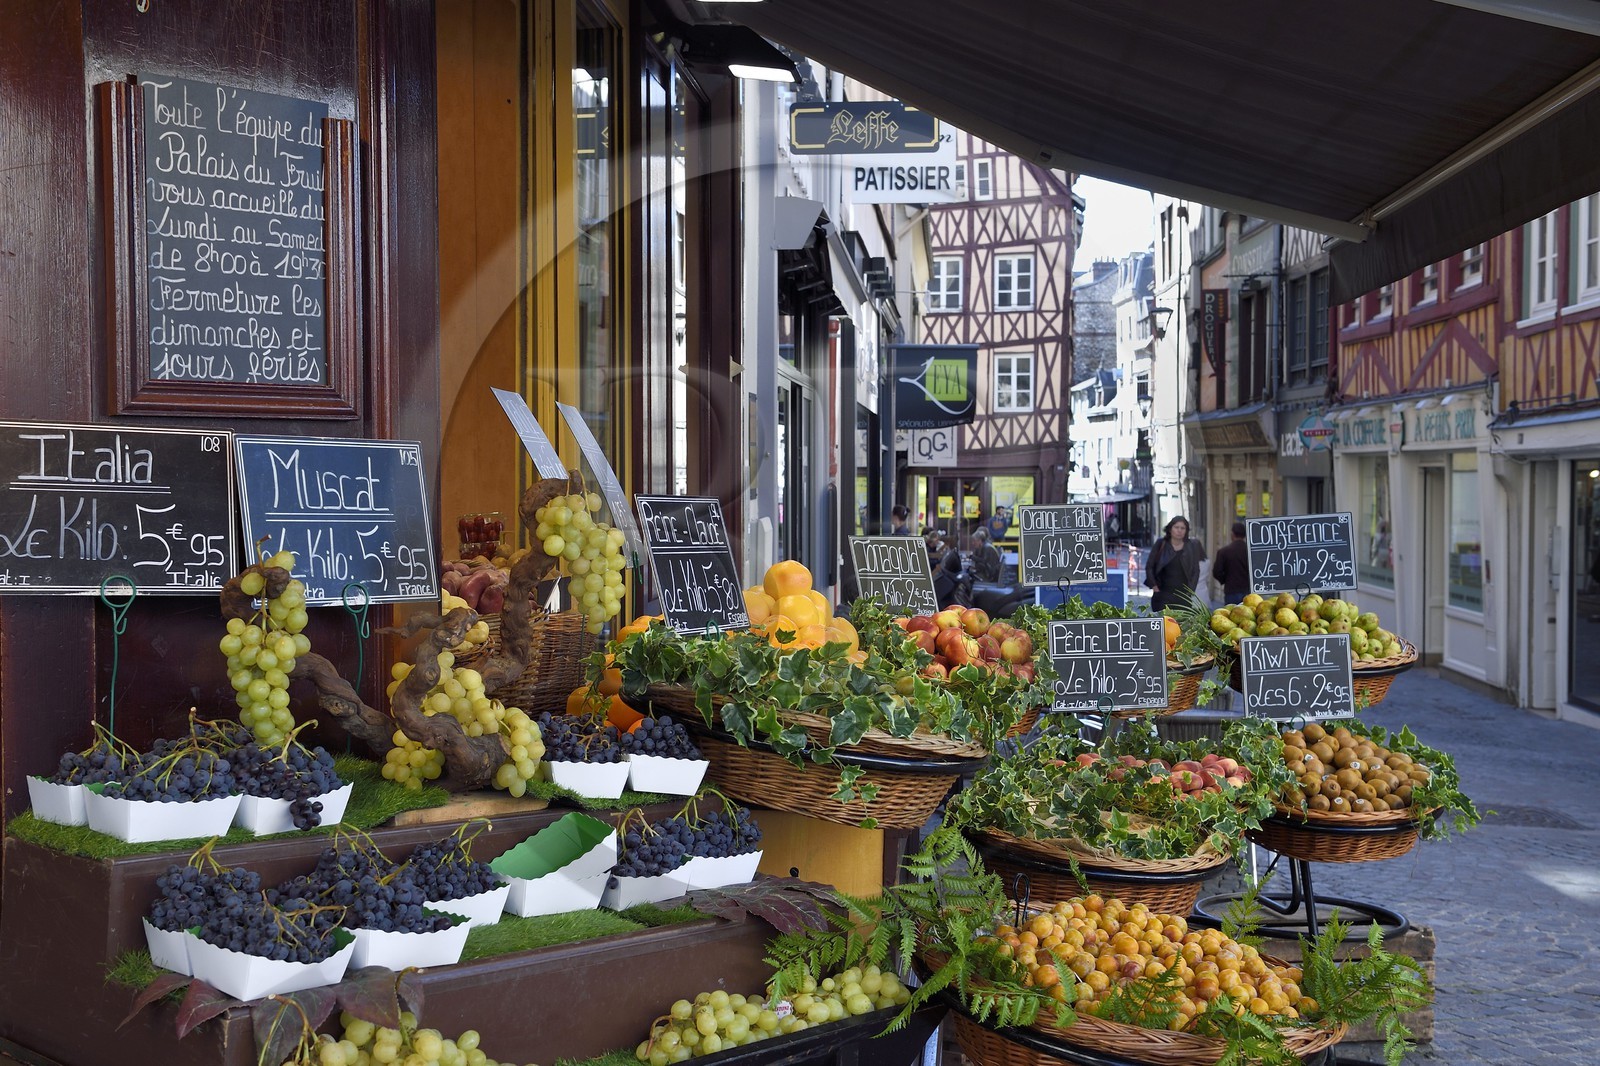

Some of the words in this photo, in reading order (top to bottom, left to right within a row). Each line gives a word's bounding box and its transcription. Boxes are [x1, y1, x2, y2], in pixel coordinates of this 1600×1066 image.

[141, 81, 206, 130] Toute
[216, 87, 294, 158] l'équipe
[298, 112, 324, 148] du
[827, 109, 900, 149] Leffe
[156, 131, 240, 181] Palais
[244, 155, 275, 186] du
[855, 166, 950, 191] PATISSIER
[147, 177, 206, 207] vous
[210, 189, 298, 219] accueille
[300, 194, 325, 221] du
[230, 226, 262, 245] au
[148, 240, 186, 271] de
[195, 242, 247, 275] 8h00
[249, 251, 269, 276] à
[150, 276, 283, 316] Fermeture
[292, 284, 321, 317] les
[149, 314, 281, 350] dimanches
[286, 321, 321, 350] et
[153, 347, 234, 380] jours
[246, 349, 320, 383] fériés
[17, 429, 154, 484] Italia
[200, 436, 221, 453] 108
[400, 448, 418, 466] 105
[918, 431, 949, 461] QG
[267, 447, 390, 512] Muscat
[1072, 507, 1098, 528] Table
[1249, 519, 1343, 550] Conférence
[398, 582, 433, 596] France
[1052, 624, 1102, 655] Pêche
[1106, 622, 1150, 651] Plate
[1150, 621, 1161, 631] 66
[1248, 641, 1288, 671] Kiwi
[1294, 638, 1334, 666] Vert
